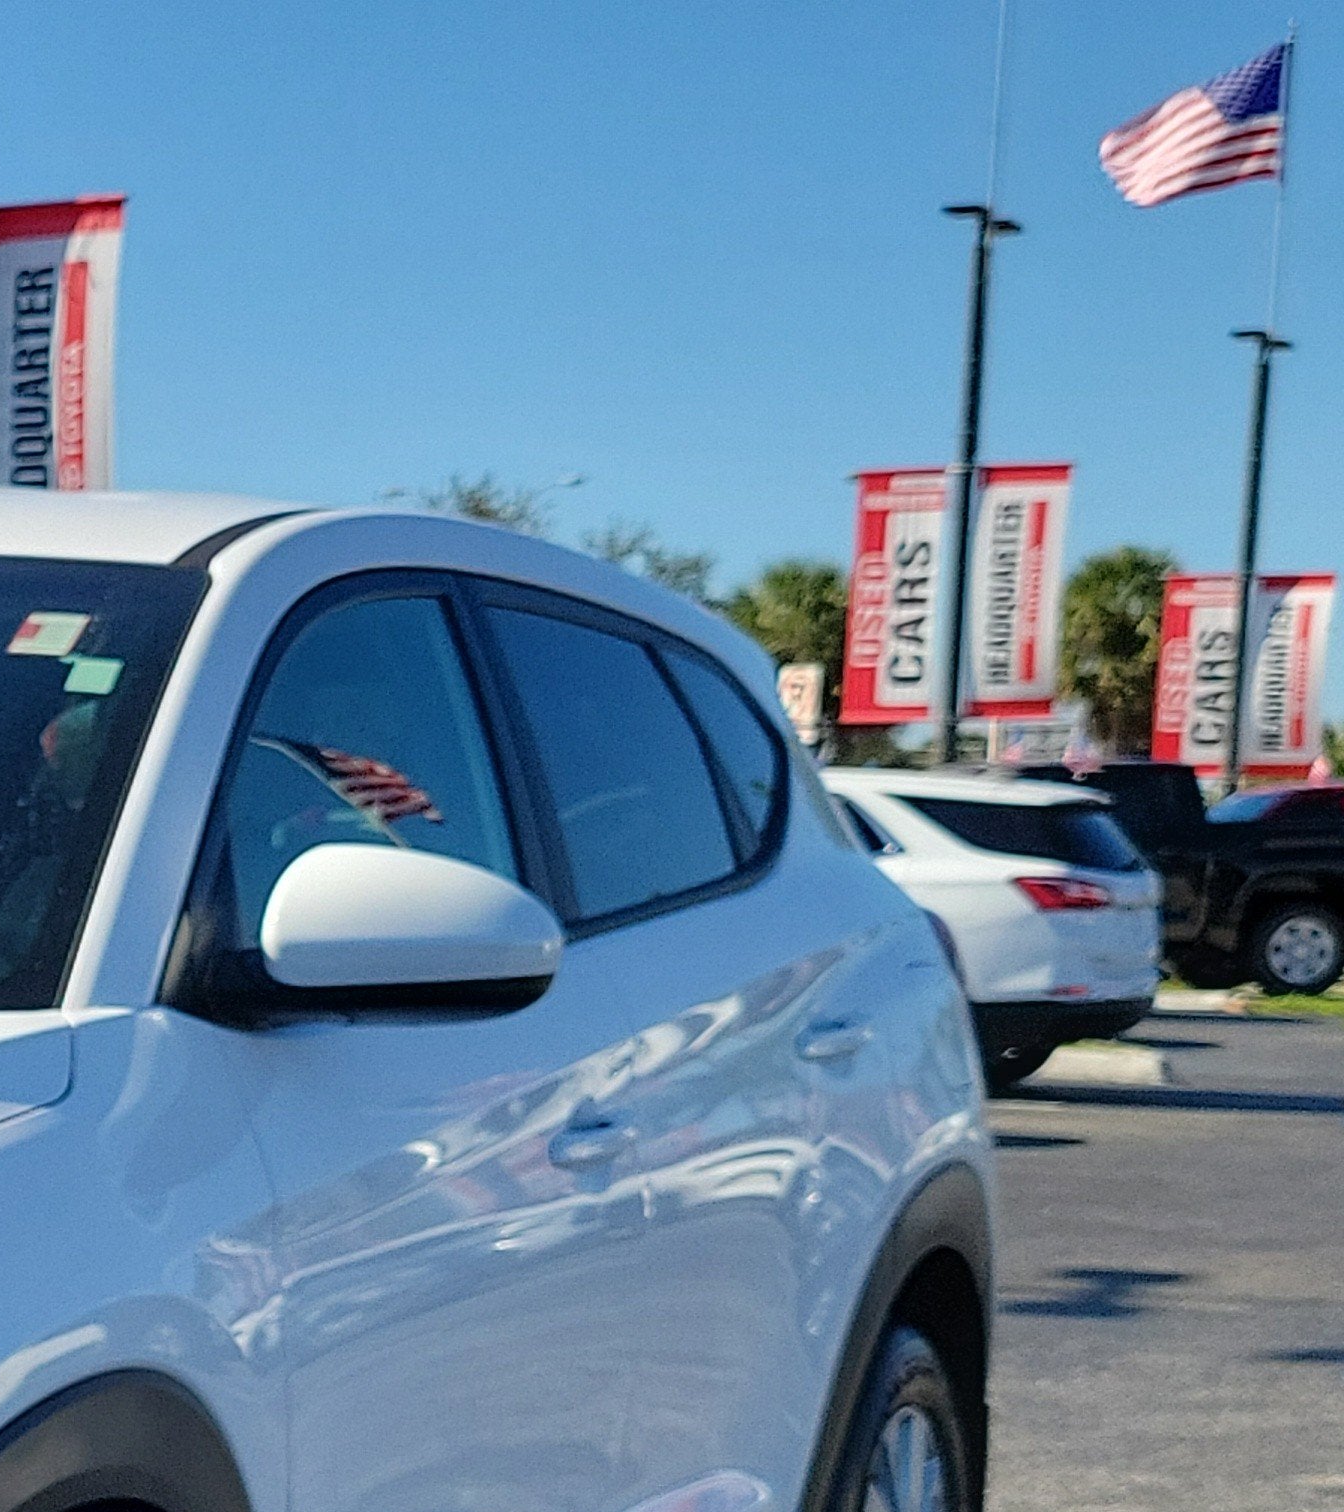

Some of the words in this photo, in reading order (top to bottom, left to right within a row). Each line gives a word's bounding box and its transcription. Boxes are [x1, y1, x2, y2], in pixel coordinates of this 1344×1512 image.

[12, 266, 55, 489] DQUARTER
[853, 559, 886, 661] USED
[891, 541, 931, 687] CARS
[1192, 630, 1235, 744] CARS
